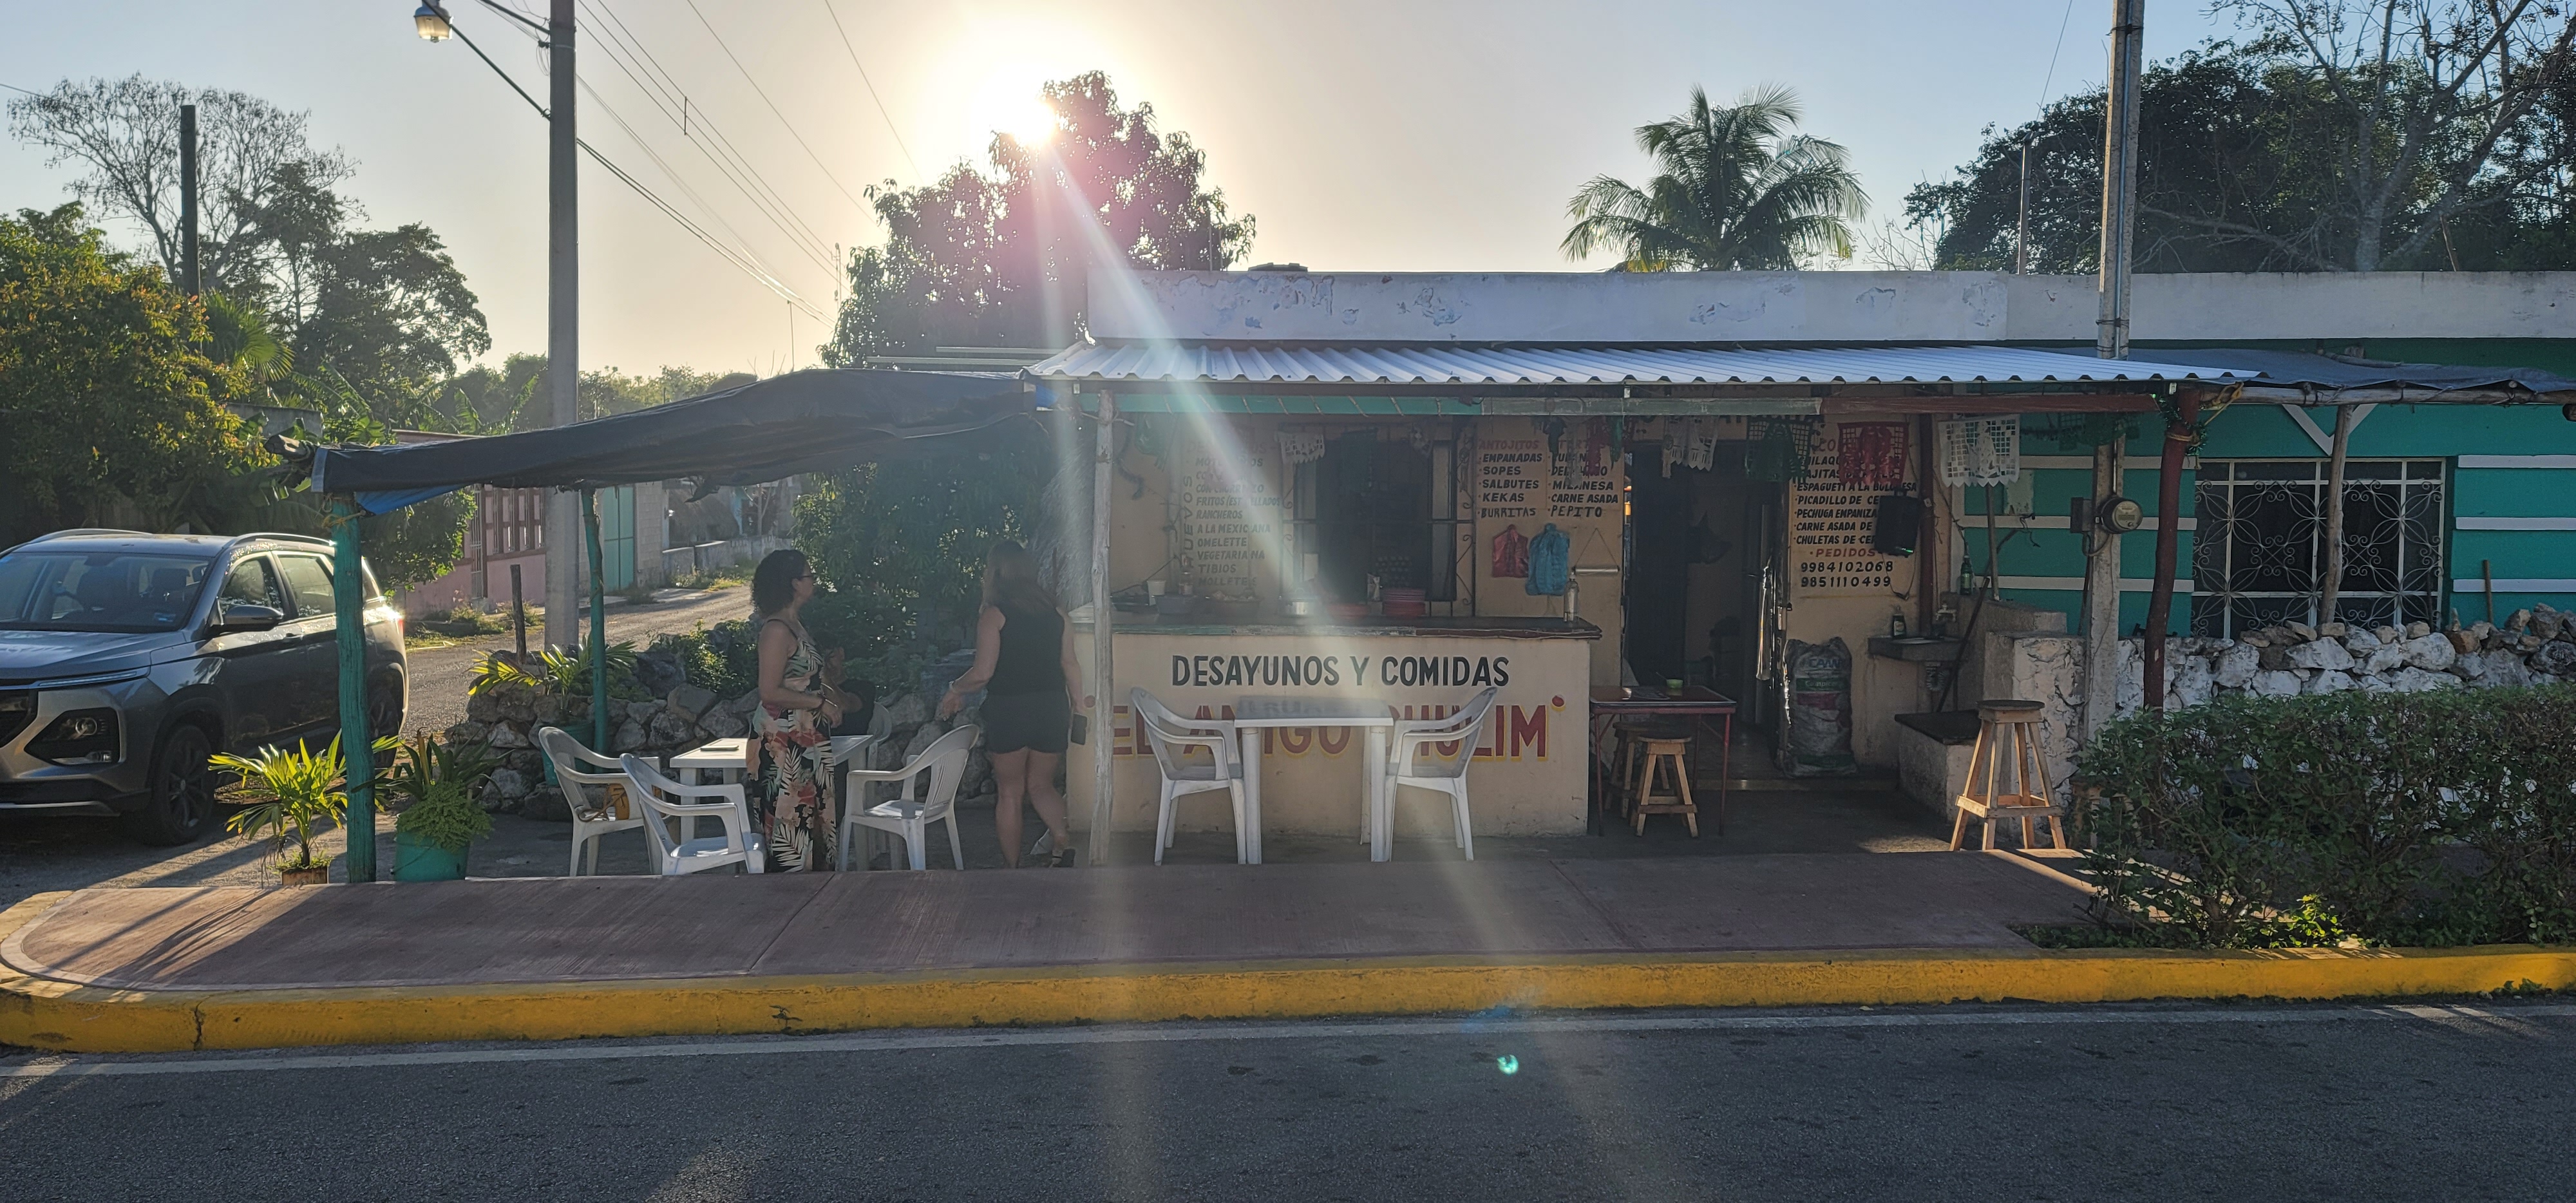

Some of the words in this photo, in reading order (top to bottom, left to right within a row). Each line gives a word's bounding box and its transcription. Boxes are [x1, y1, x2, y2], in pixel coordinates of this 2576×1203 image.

[1478, 440, 1539, 450] ANTOJITOS
[1482, 453, 1542, 462] EMPANADAS
[1482, 466, 1521, 476] SOPES
[1803, 469, 1840, 478] AJITAS
[1482, 479, 1539, 489] SALBUTES
[1797, 482, 1846, 491] ESPAGUETI
[1848, 483, 1855, 491] A
[1873, 482, 1917, 491] BOLESA
[1196, 497, 1225, 506] FRITOS
[1226, 495, 1281, 507] (ESTELLADOS
[1482, 493, 1524, 502] KEKAS
[1551, 493, 1584, 503] CARNE
[1586, 494, 1618, 504] ASADA
[1797, 496, 1846, 505] PICADILLO
[1848, 496, 1862, 504] DE
[1196, 510, 1243, 520] RANCHEROS
[1481, 507, 1537, 518] BURRITAS
[1550, 506, 1602, 518] PEPITO
[1796, 509, 1833, 518] PECHUGA
[1835, 508, 1877, 518] EMPANIZA
[1197, 524, 1203, 533] A
[1206, 524, 1216, 533] LA
[1218, 524, 1271, 533] MEXICANA
[1796, 522, 1825, 531] CARNE
[1827, 522, 1856, 531] ASADA
[1860, 522, 1872, 531] DE
[1197, 538, 1247, 547] OMELETTE
[1796, 535, 1840, 545] CHULETAS
[1842, 535, 1856, 544] DE
[1197, 551, 1265, 560] VEGETARIANA
[1815, 548, 1876, 557] PEDIDOS
[1198, 564, 1236, 573] TIBIOS
[1801, 561, 1893, 573] 9984102068
[1198, 577, 1257, 586] MOLLETES
[1801, 576, 1891, 587] 9851110499
[1172, 655, 1340, 687] DESAYUNOS
[1350, 656, 1370, 686] Y
[1381, 655, 1510, 687] COMIDAS
[1183, 705, 1352, 759] AIGO
[1386, 705, 1548, 760] HULIM
